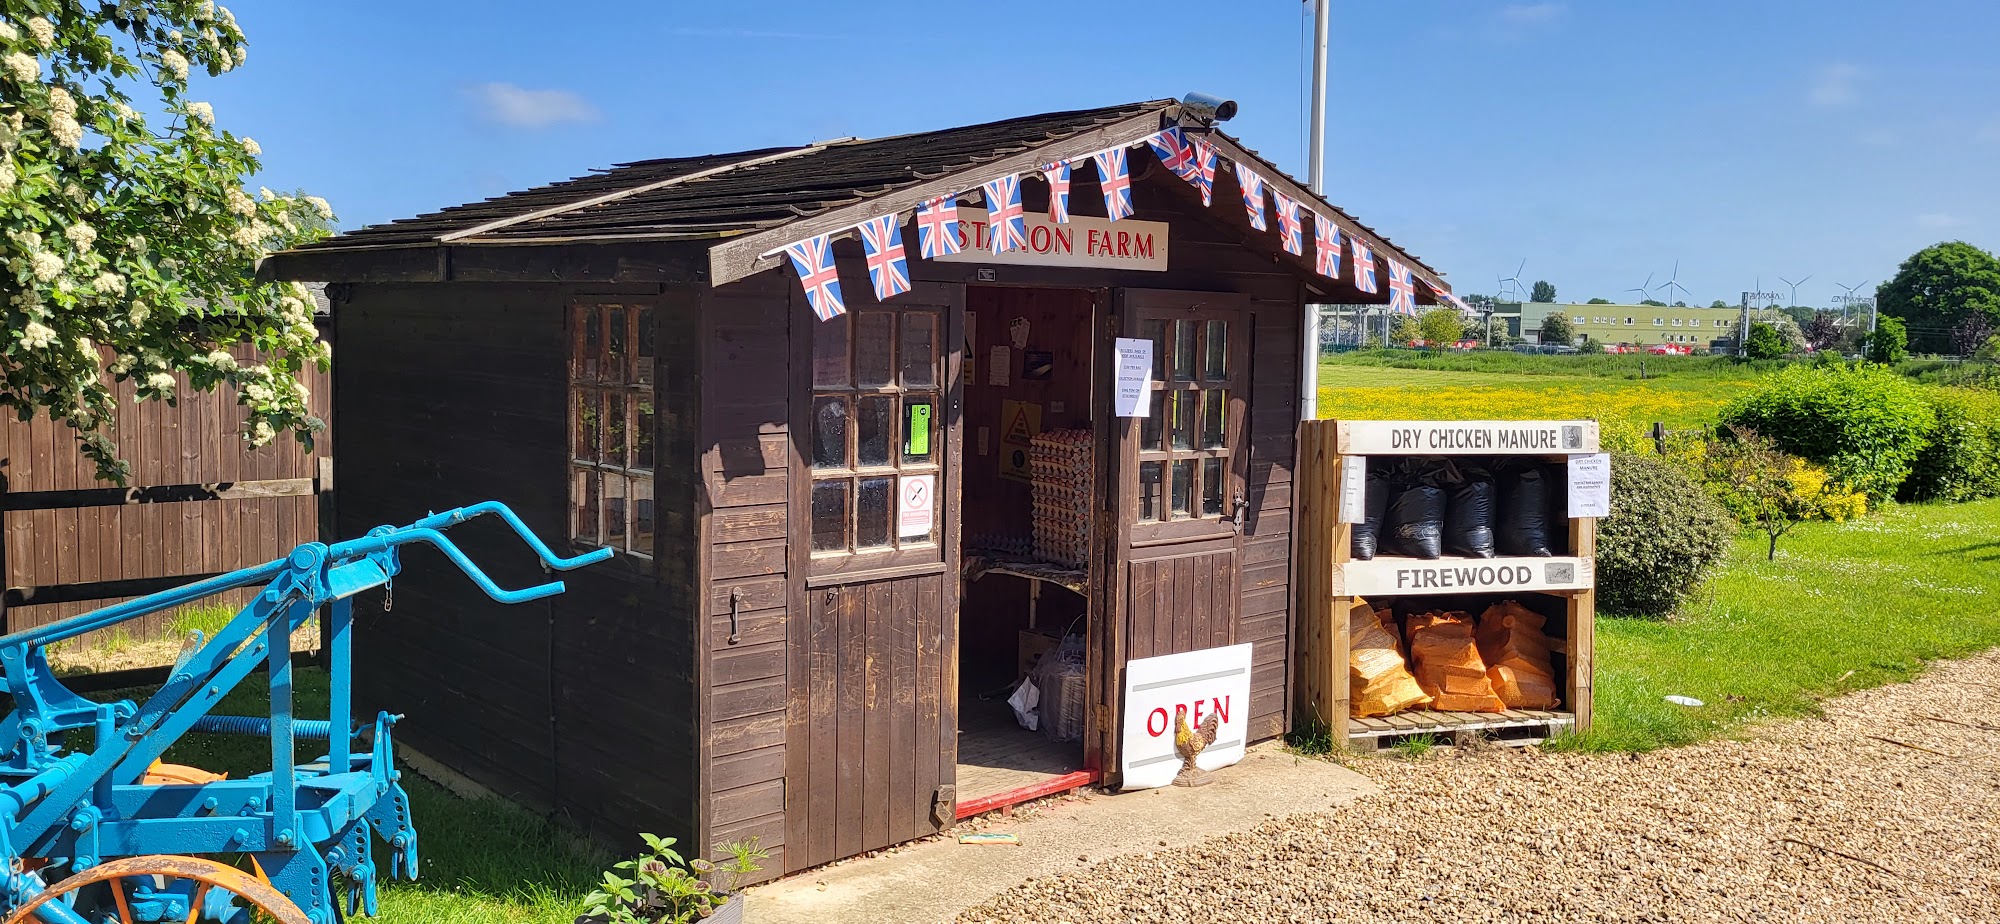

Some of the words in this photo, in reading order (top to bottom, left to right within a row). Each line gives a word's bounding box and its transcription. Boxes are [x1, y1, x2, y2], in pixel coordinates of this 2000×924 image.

[958, 219, 1073, 255] STON
[1087, 229, 1154, 259] FARM
[1391, 428, 1422, 449] DRY
[1428, 428, 1492, 449] CHICKEN
[1498, 428, 1557, 449] MANURE
[1396, 565, 1532, 589] FIREWOOD
